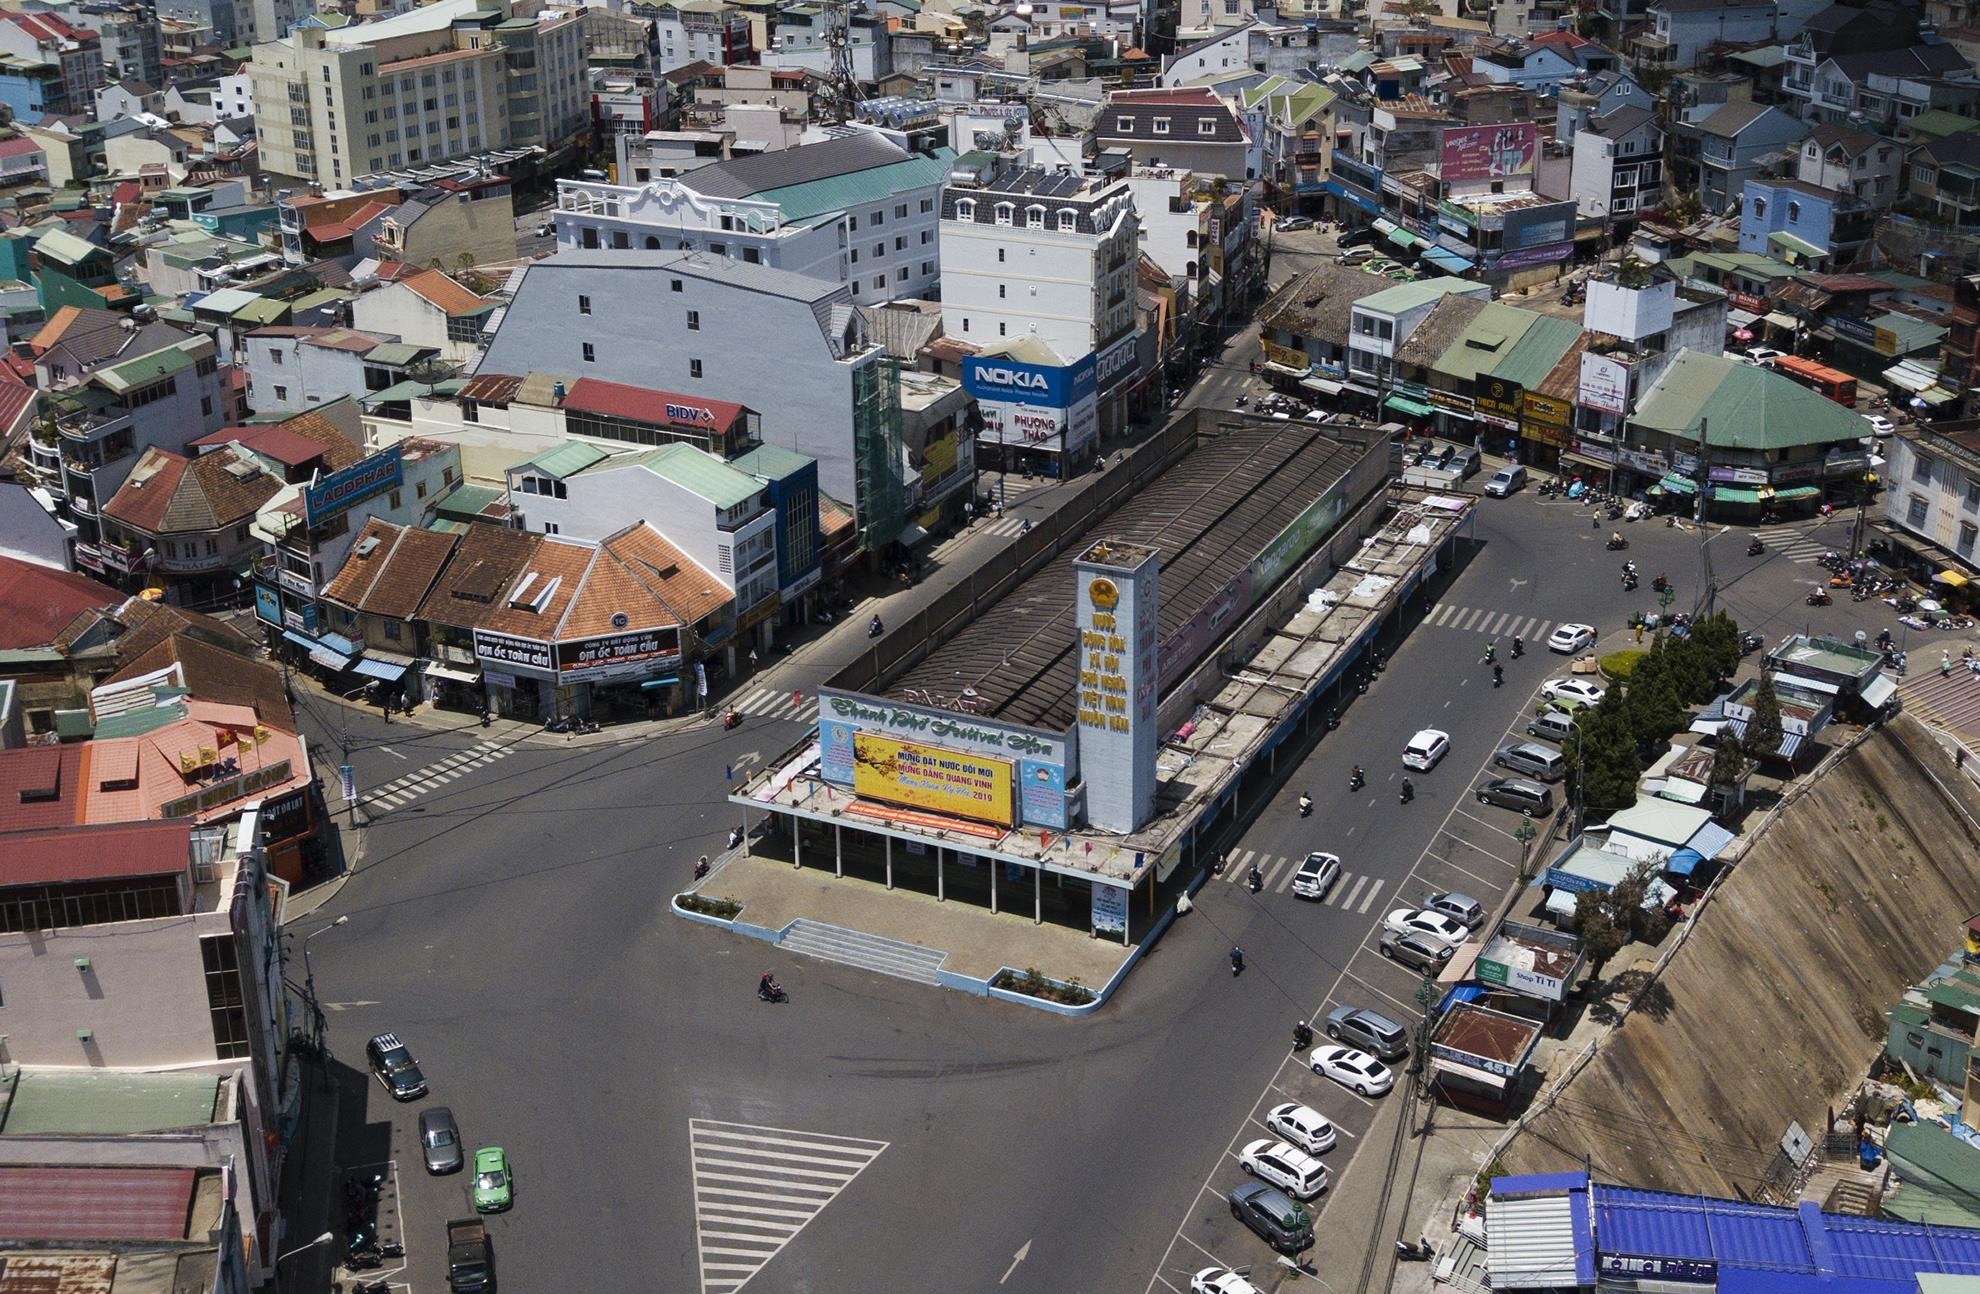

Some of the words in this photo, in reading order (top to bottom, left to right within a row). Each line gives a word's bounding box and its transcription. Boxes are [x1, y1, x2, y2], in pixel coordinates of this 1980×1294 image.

[975, 366, 1048, 390] NOKIA
[665, 403, 700, 421] BIDV
[312, 461, 396, 509] LADOPHAR
[507, 649, 530, 663] TOÀN
[615, 643, 637, 655] TOÀN
[1105, 694, 1126, 713] NAM
[931, 720, 1004, 747] Festival
[1007, 734, 1053, 756] Hoa
[897, 751, 920, 763] MỪNG
[923, 755, 937, 766] ĐẤT
[939, 758, 960, 772] NƯỚC
[963, 763, 975, 774] ĐỔI
[978, 767, 993, 778] MỚI
[897, 763, 920, 775] MỪNG
[923, 767, 944, 780] ĐẢNG
[946, 774, 972, 786] QUANG
[974, 779, 992, 790] VINH
[973, 791, 992, 802] 2019
[1536, 975, 1545, 985] Ti
[1547, 978, 1556, 988] Ti
